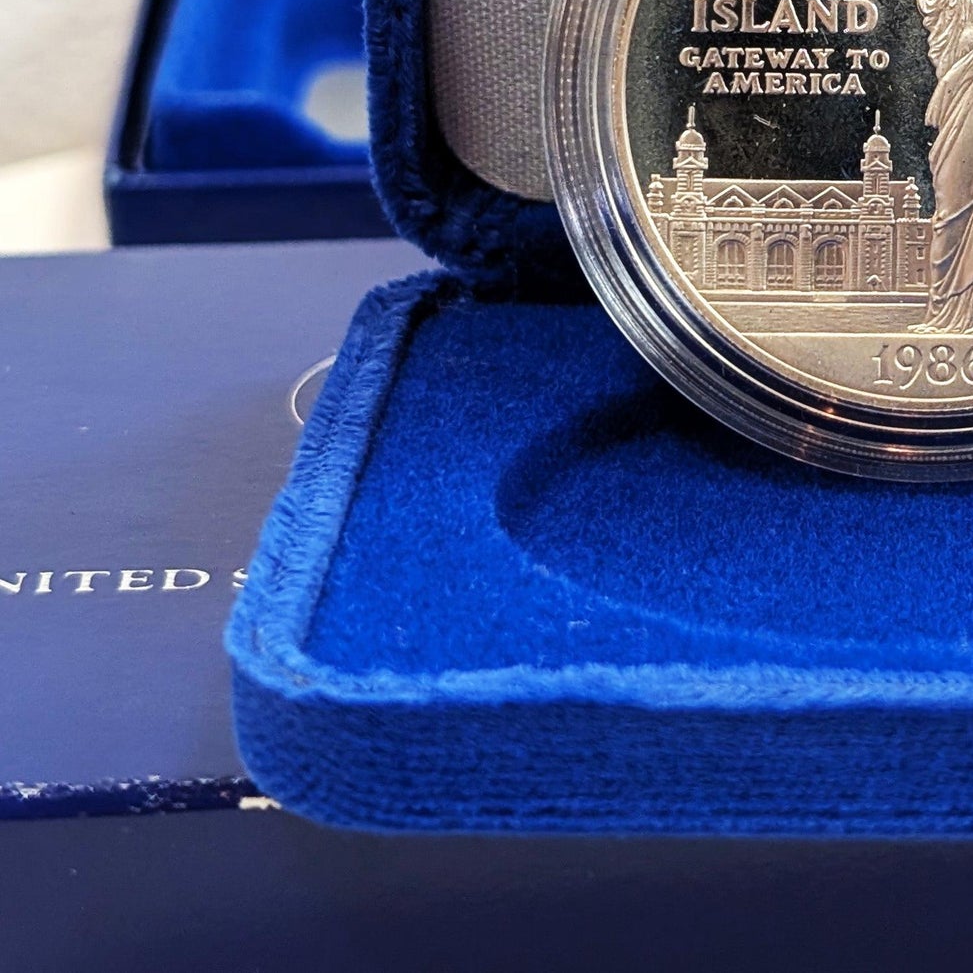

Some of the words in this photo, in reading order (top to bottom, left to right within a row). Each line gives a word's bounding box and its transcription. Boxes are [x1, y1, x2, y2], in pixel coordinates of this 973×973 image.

[678, 46, 835, 71] GATEWAY
[845, 48, 890, 71] TO
[702, 71, 866, 95] AMERICA
